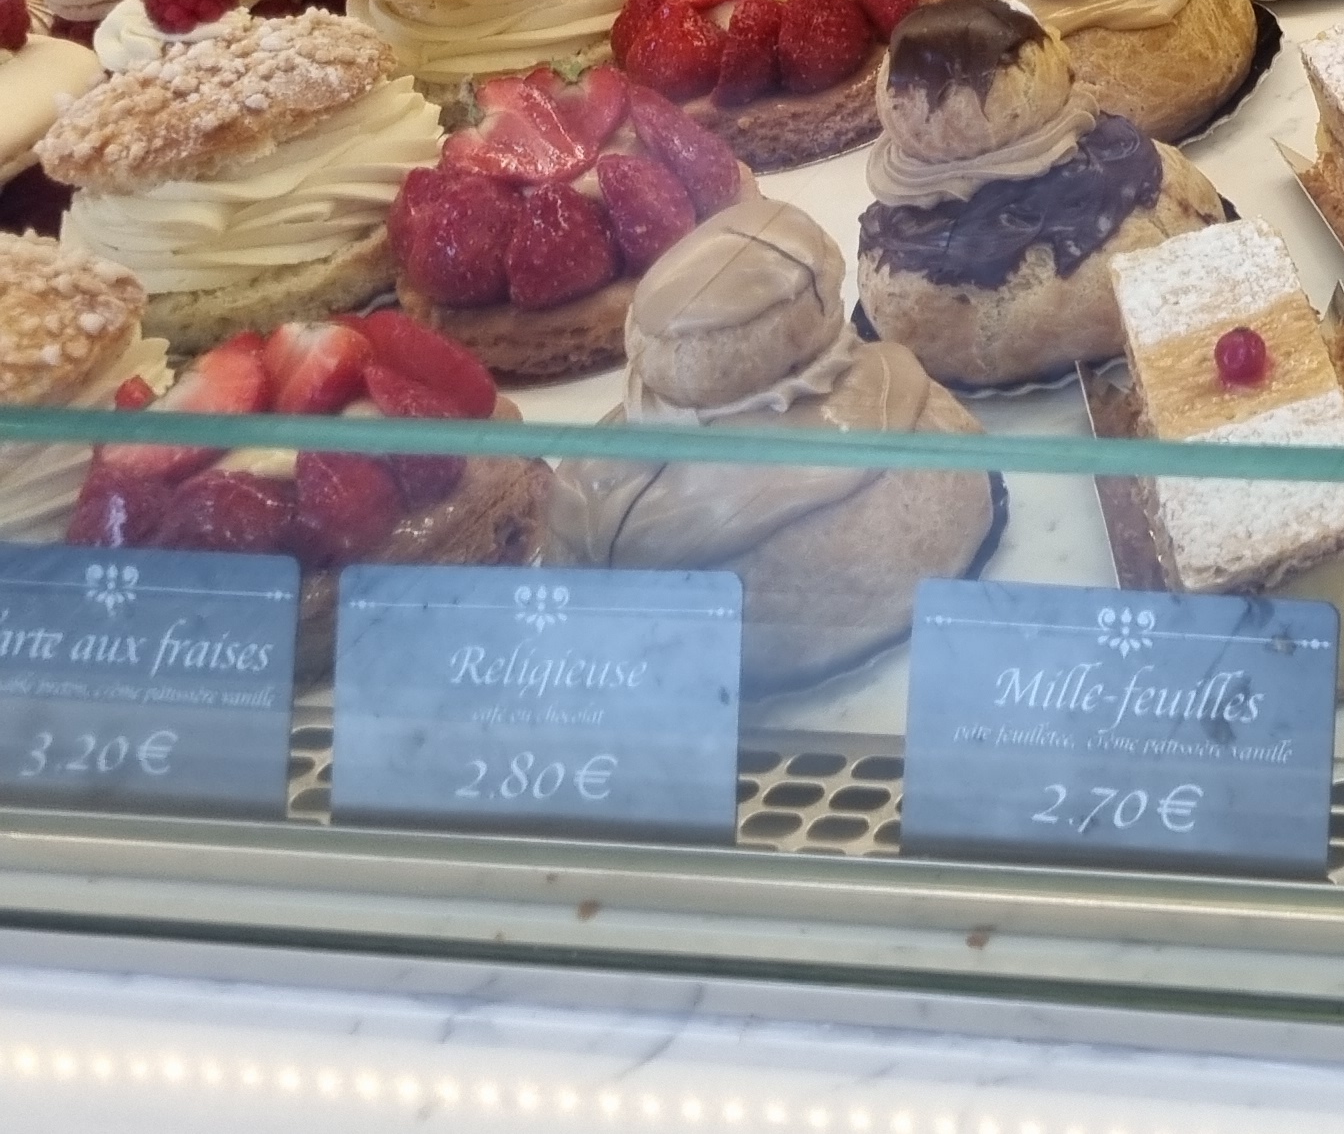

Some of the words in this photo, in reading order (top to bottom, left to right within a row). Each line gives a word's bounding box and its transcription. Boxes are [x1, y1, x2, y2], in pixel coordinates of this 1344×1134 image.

[70, 633, 147, 664] aux
[149, 618, 274, 679] fraises
[450, 638, 648, 697] Religieuse
[994, 662, 1266, 734] Mille-feuilles
[18, 730, 179, 776] 3.20€
[455, 751, 618, 800] 2.80€
[1232, 739, 1293, 764] vanille
[1031, 783, 1204, 834] 2.70€
